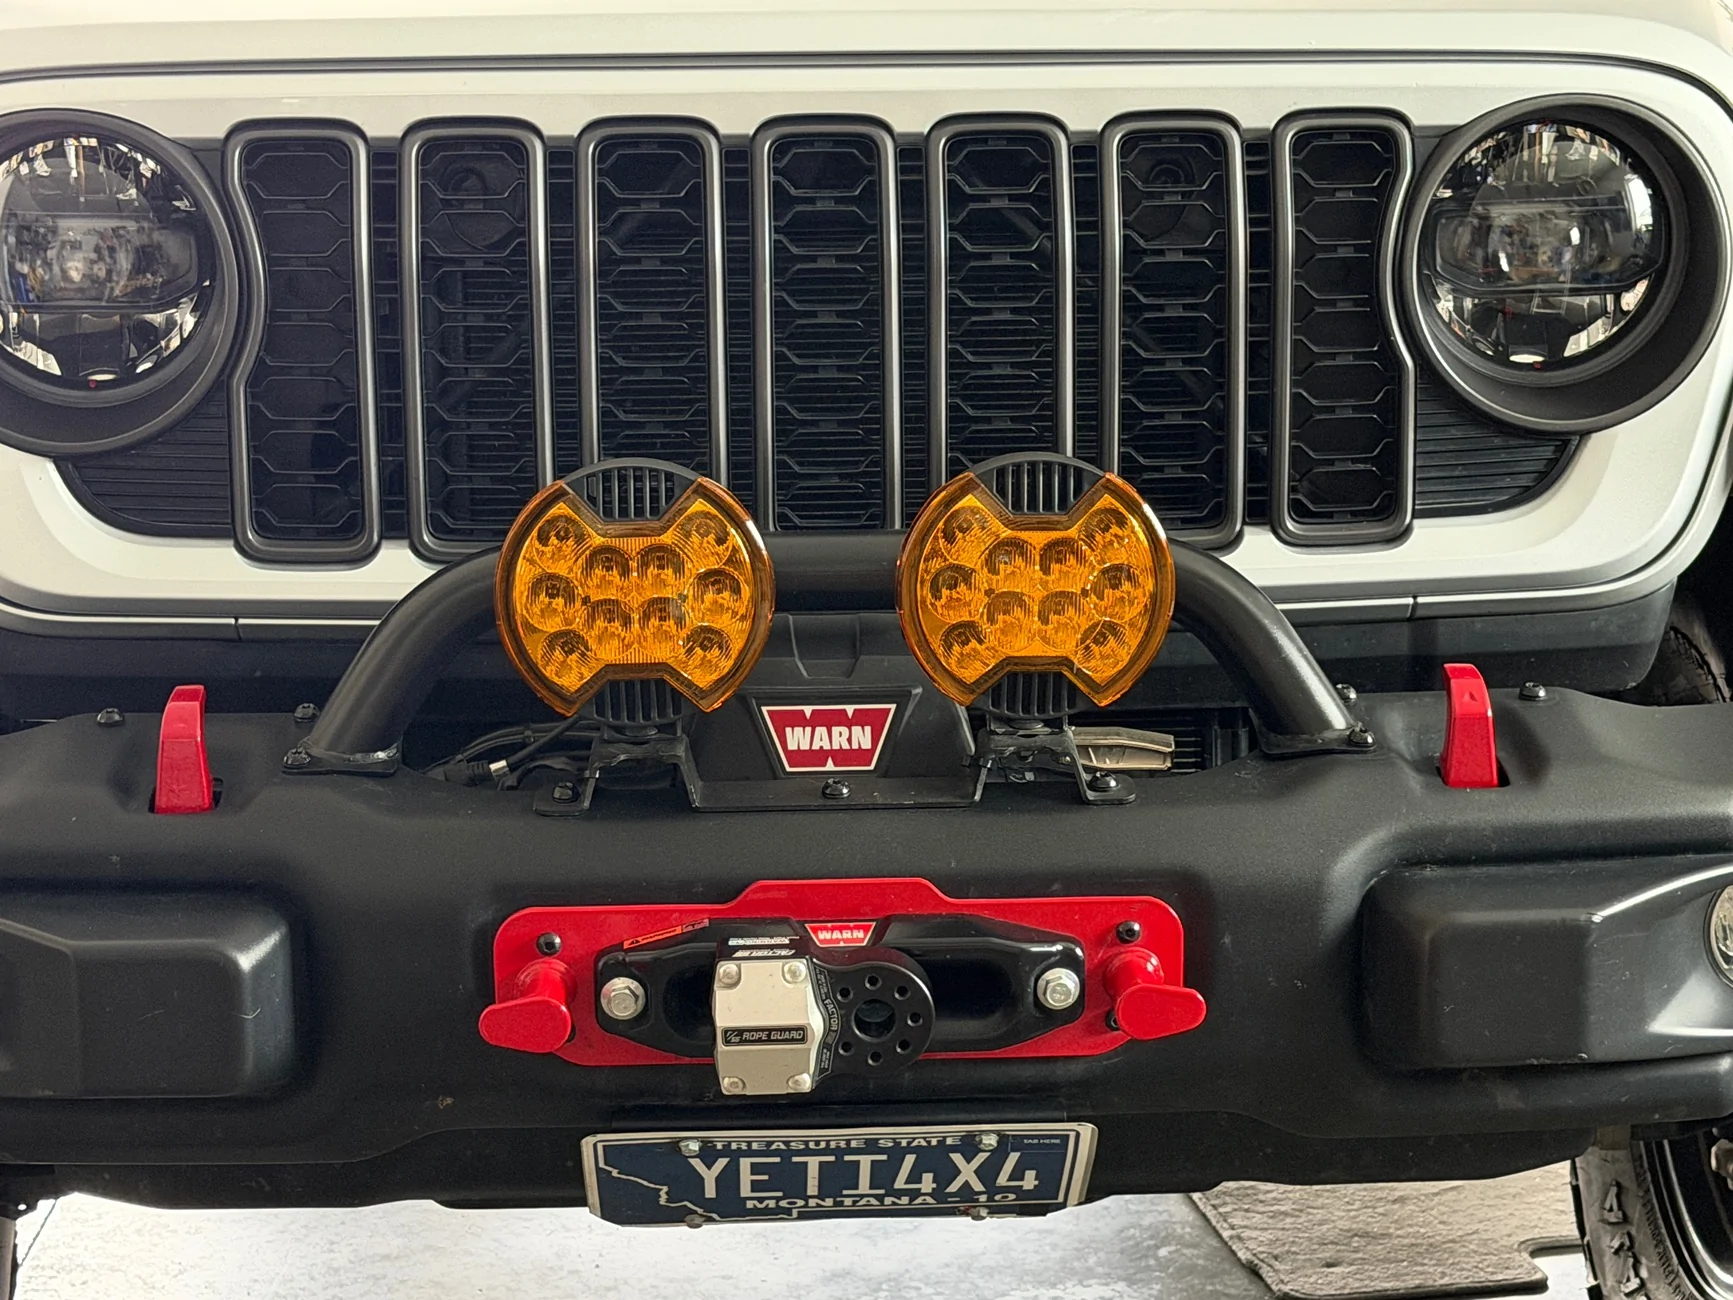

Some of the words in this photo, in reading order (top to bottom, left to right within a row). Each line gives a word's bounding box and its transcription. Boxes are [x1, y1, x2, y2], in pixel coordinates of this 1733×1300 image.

[785, 725, 872, 750] WARN
[817, 929, 865, 940] WARN
[824, 999, 838, 1031] FACTOR
[742, 1031, 769, 1040] ROPE
[770, 1030, 803, 1040] GUARD
[713, 1139, 866, 1150] TREASURE
[877, 1136, 962, 1147] STATE
[687, 1152, 1040, 1198] YETI4X4
[746, 1195, 938, 1209] MONTANA
[973, 1193, 1017, 1203] 10
